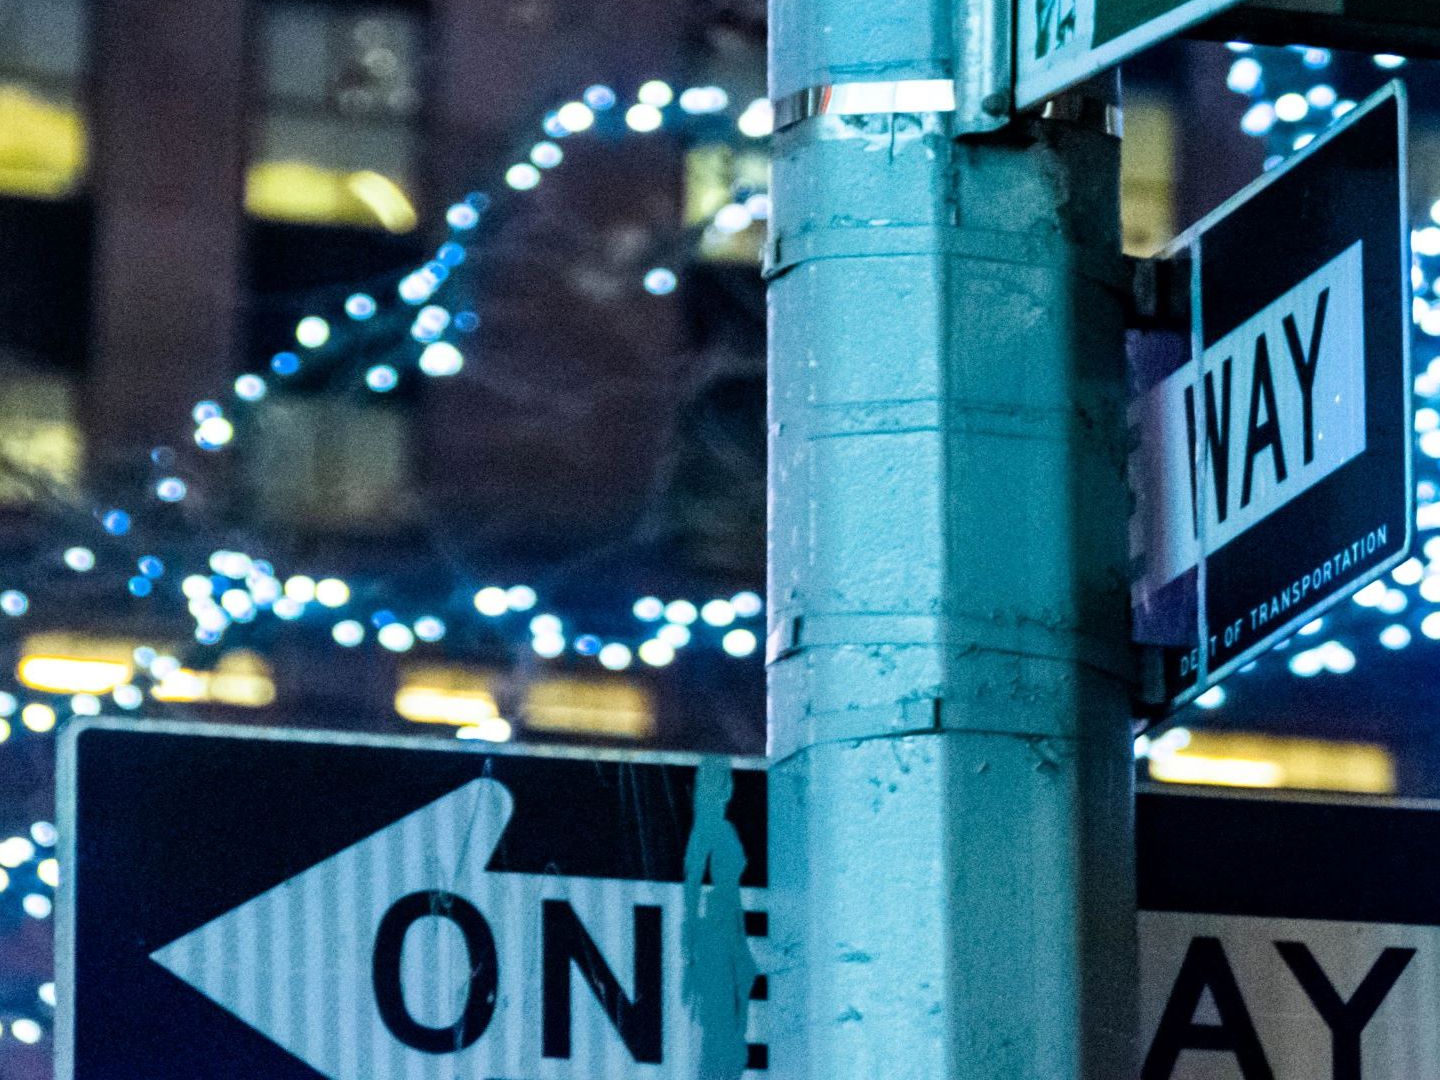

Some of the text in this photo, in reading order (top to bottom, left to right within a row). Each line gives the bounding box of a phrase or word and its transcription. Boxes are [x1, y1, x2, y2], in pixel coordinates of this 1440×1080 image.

[1184, 285, 1330, 541] WAY
[1179, 524, 1388, 677] DET OF TRANSPORTATION
[1138, 936, 1418, 1080] AY
